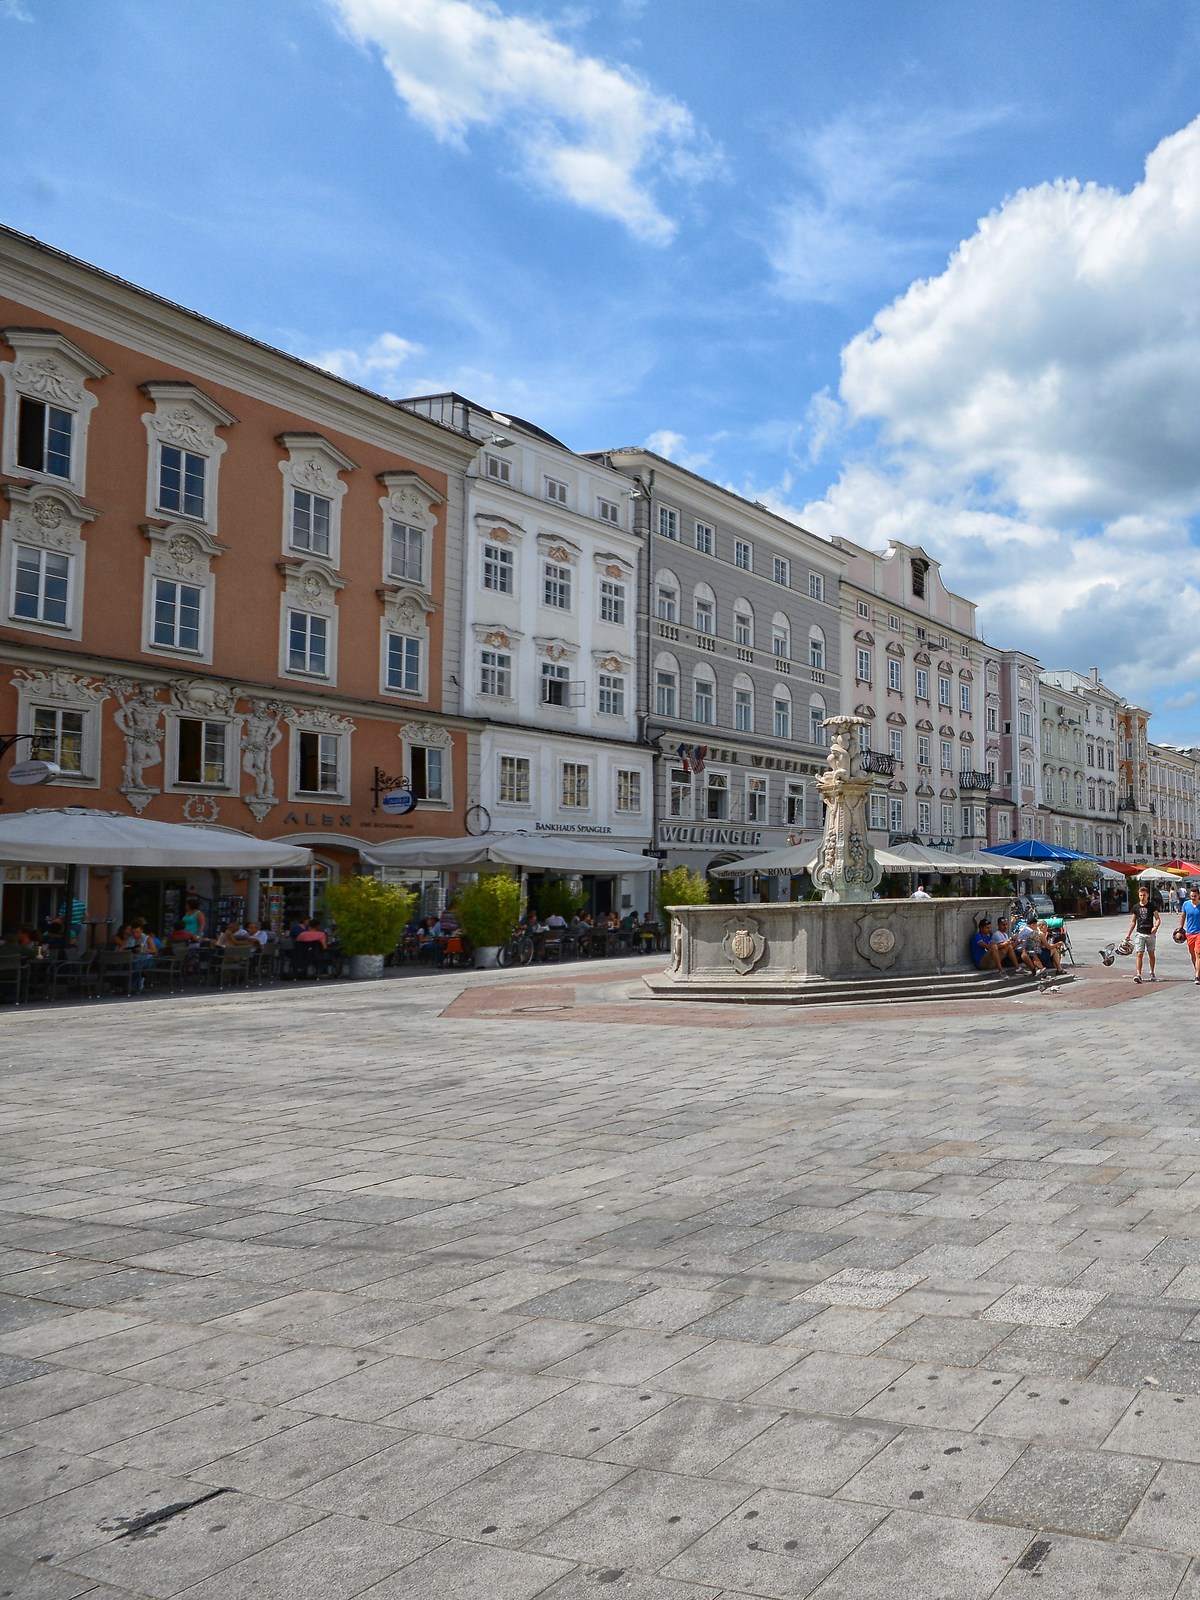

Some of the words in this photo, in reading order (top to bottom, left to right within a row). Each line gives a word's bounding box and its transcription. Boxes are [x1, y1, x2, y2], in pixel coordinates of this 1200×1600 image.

[196, 804, 205, 813] 21
[284, 814, 353, 827] ALEX
[535, 822, 575, 832] BANKHAUS
[664, 827, 762, 845] WOLFINGER
[768, 868, 792, 876] ROMA
